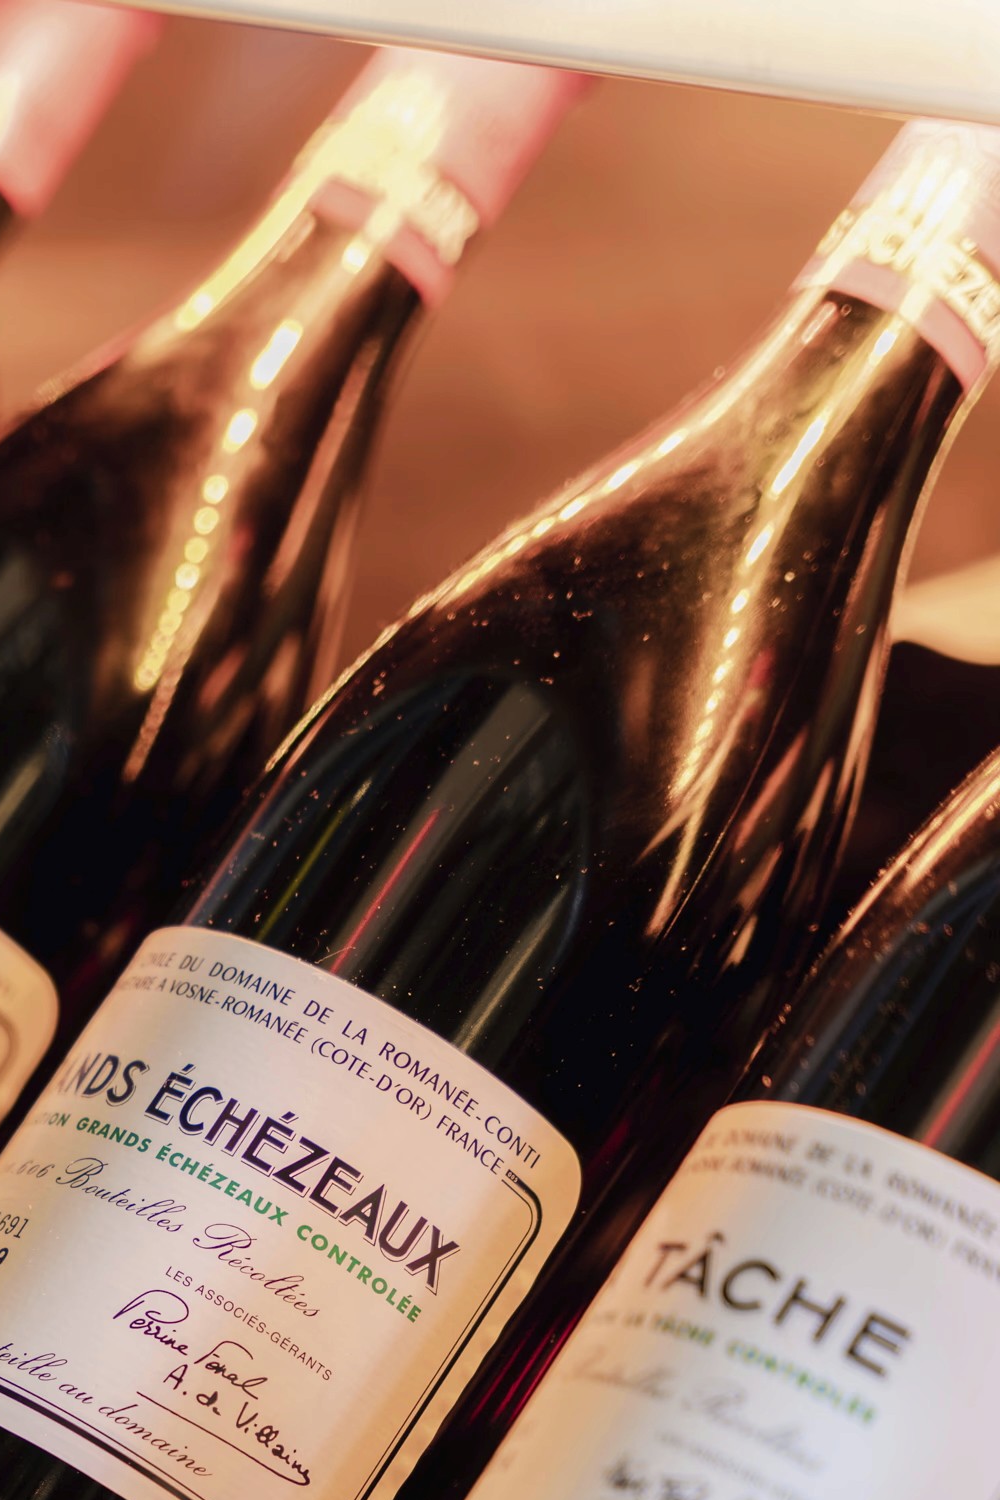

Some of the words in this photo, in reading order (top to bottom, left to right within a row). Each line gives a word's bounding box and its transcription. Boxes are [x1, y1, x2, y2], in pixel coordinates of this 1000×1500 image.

[169, 979, 308, 1044] VOSNE-ROMANÉE
[436, 1115, 504, 1175] FRANCE
[179, 955, 205, 972] DU
[208, 962, 296, 1006] DOMAINE
[303, 1000, 334, 1024] DE
[341, 1020, 368, 1046] LA
[378, 1042, 541, 1169] ROMANÉE-CONTI
[55, 1157, 187, 1232] Bouteilles
[192, 1223, 321, 1317] Récoltées
[76, 1116, 152, 1153] GRANDS
[155, 1143, 289, 1227] ÉCHÉZEAUX
[296, 1224, 422, 1323] CONTROLÉE
[144, 1063, 461, 1296] ÉCHÉZEAUX
[165, 1265, 193, 1287] LES
[195, 1284, 333, 1381] ASSOCIÉS-GÉRANTS
[643, 1230, 913, 1378] TÂCHE
[58, 1382, 94, 1405] au
[98, 1403, 213, 1477] domaine
